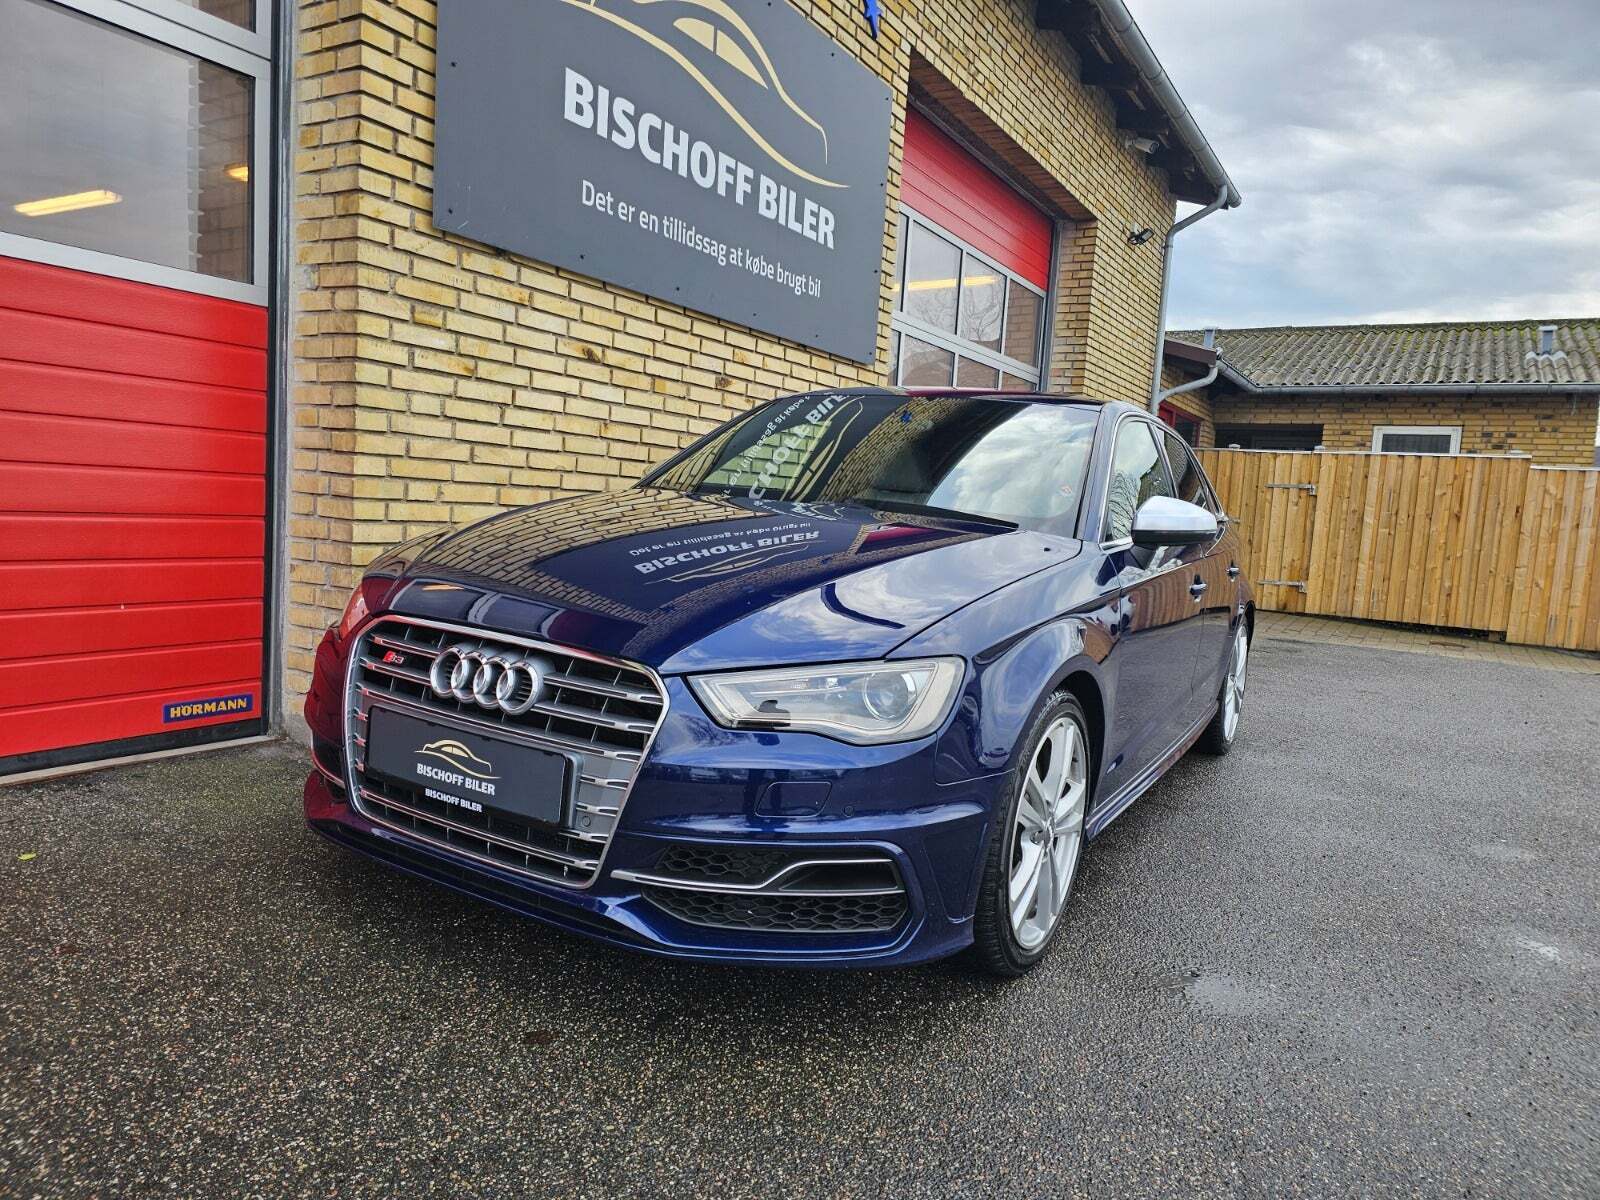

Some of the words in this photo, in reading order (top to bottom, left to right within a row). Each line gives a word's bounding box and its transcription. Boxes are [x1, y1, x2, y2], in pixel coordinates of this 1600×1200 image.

[564, 66, 755, 206] BISCHOFF
[758, 174, 835, 249] BILER
[582, 179, 614, 216] Det
[618, 201, 636, 223] er
[639, 210, 659, 233] en
[662, 215, 727, 266] tillidssag
[729, 247, 743, 267] at
[745, 249, 775, 279] købe
[776, 262, 807, 296] brugt
[808, 275, 821, 298] bil
[416, 762, 465, 786] BISCHOFF
[464, 777, 496, 796] BILER
[425, 788, 460, 806] BISCHOFF
[460, 798, 483, 813] BILER
